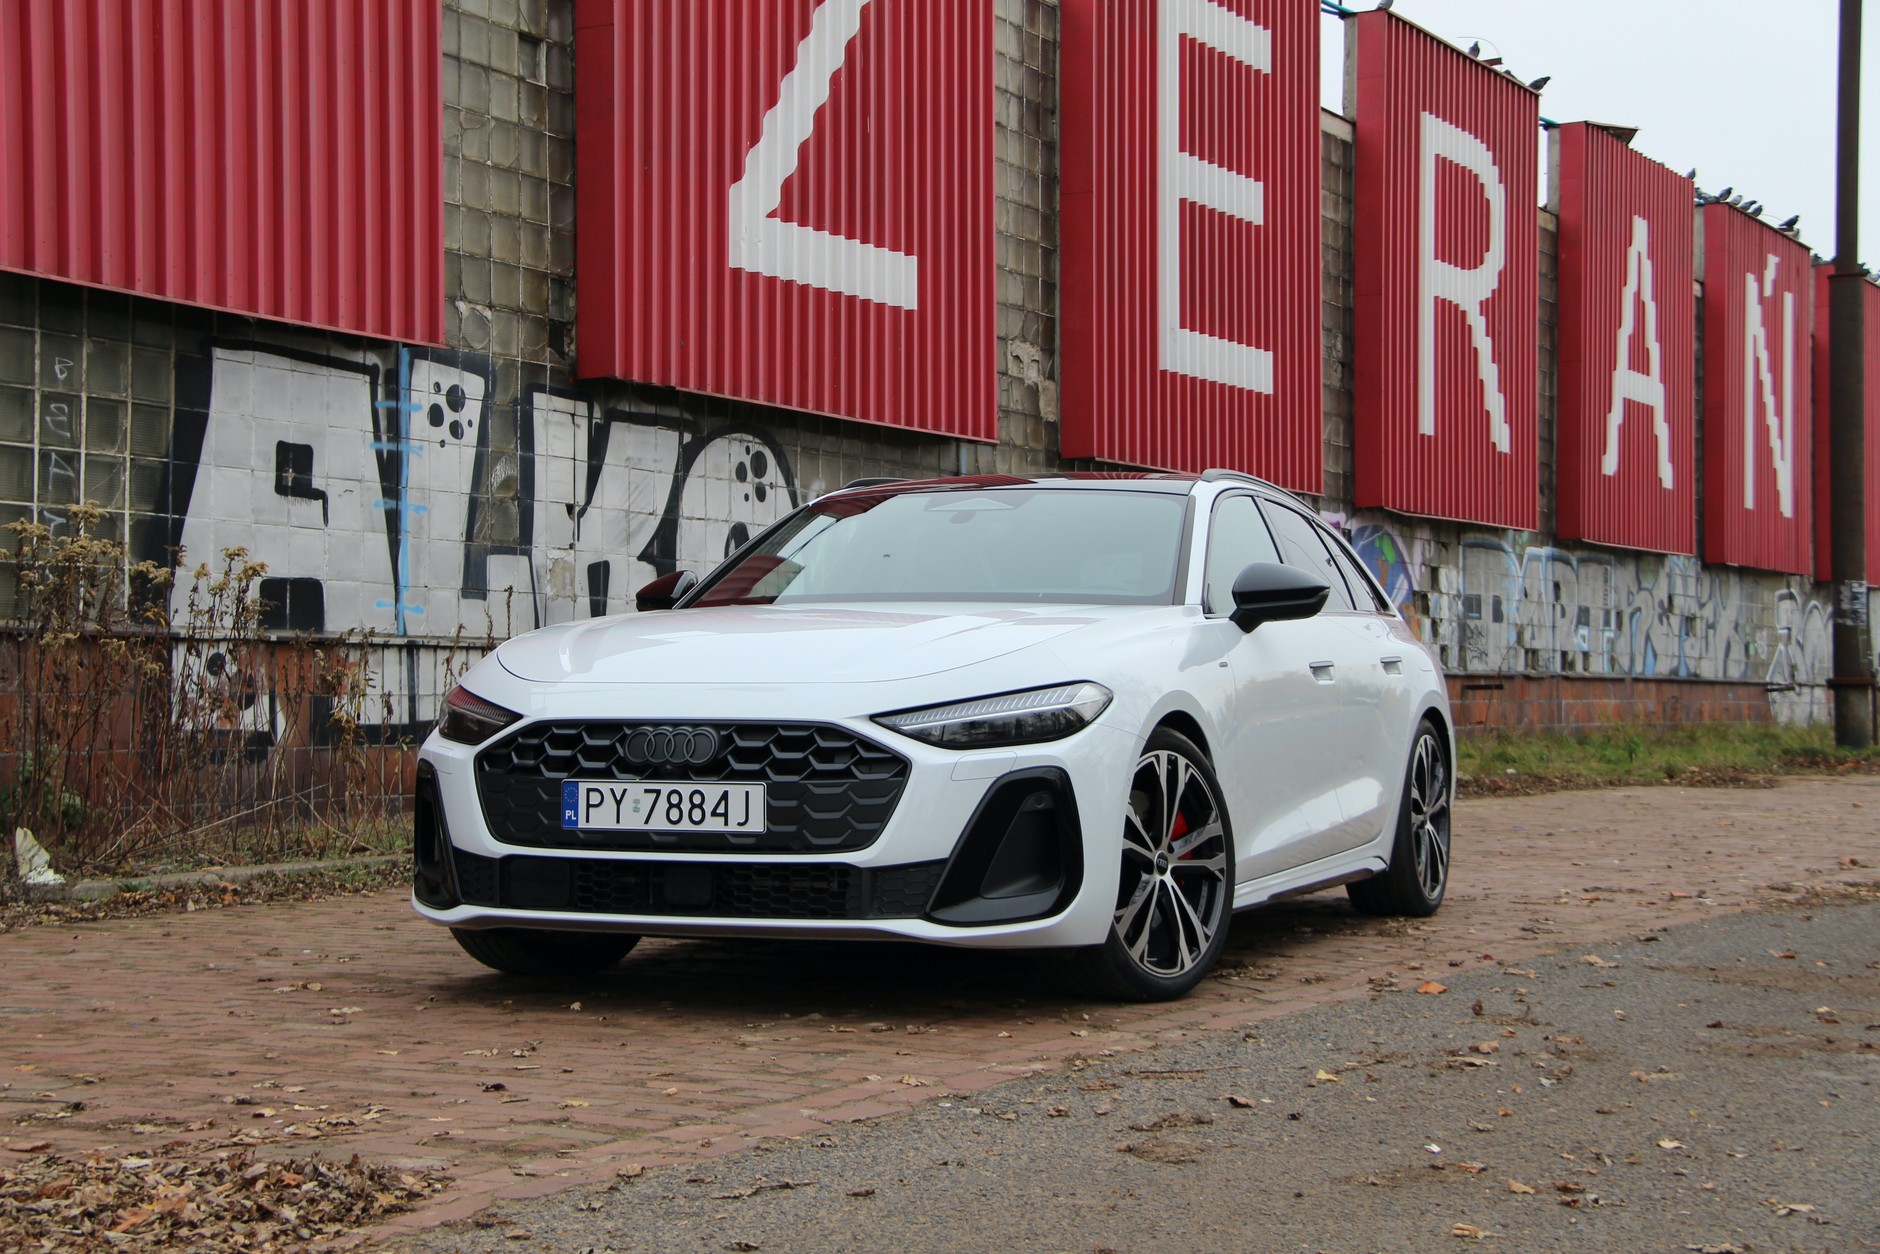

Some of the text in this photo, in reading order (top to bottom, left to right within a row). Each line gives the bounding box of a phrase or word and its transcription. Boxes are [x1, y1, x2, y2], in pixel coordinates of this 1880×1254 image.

[565, 810, 577, 820] PL
[585, 787, 750, 827] PY 7884J
